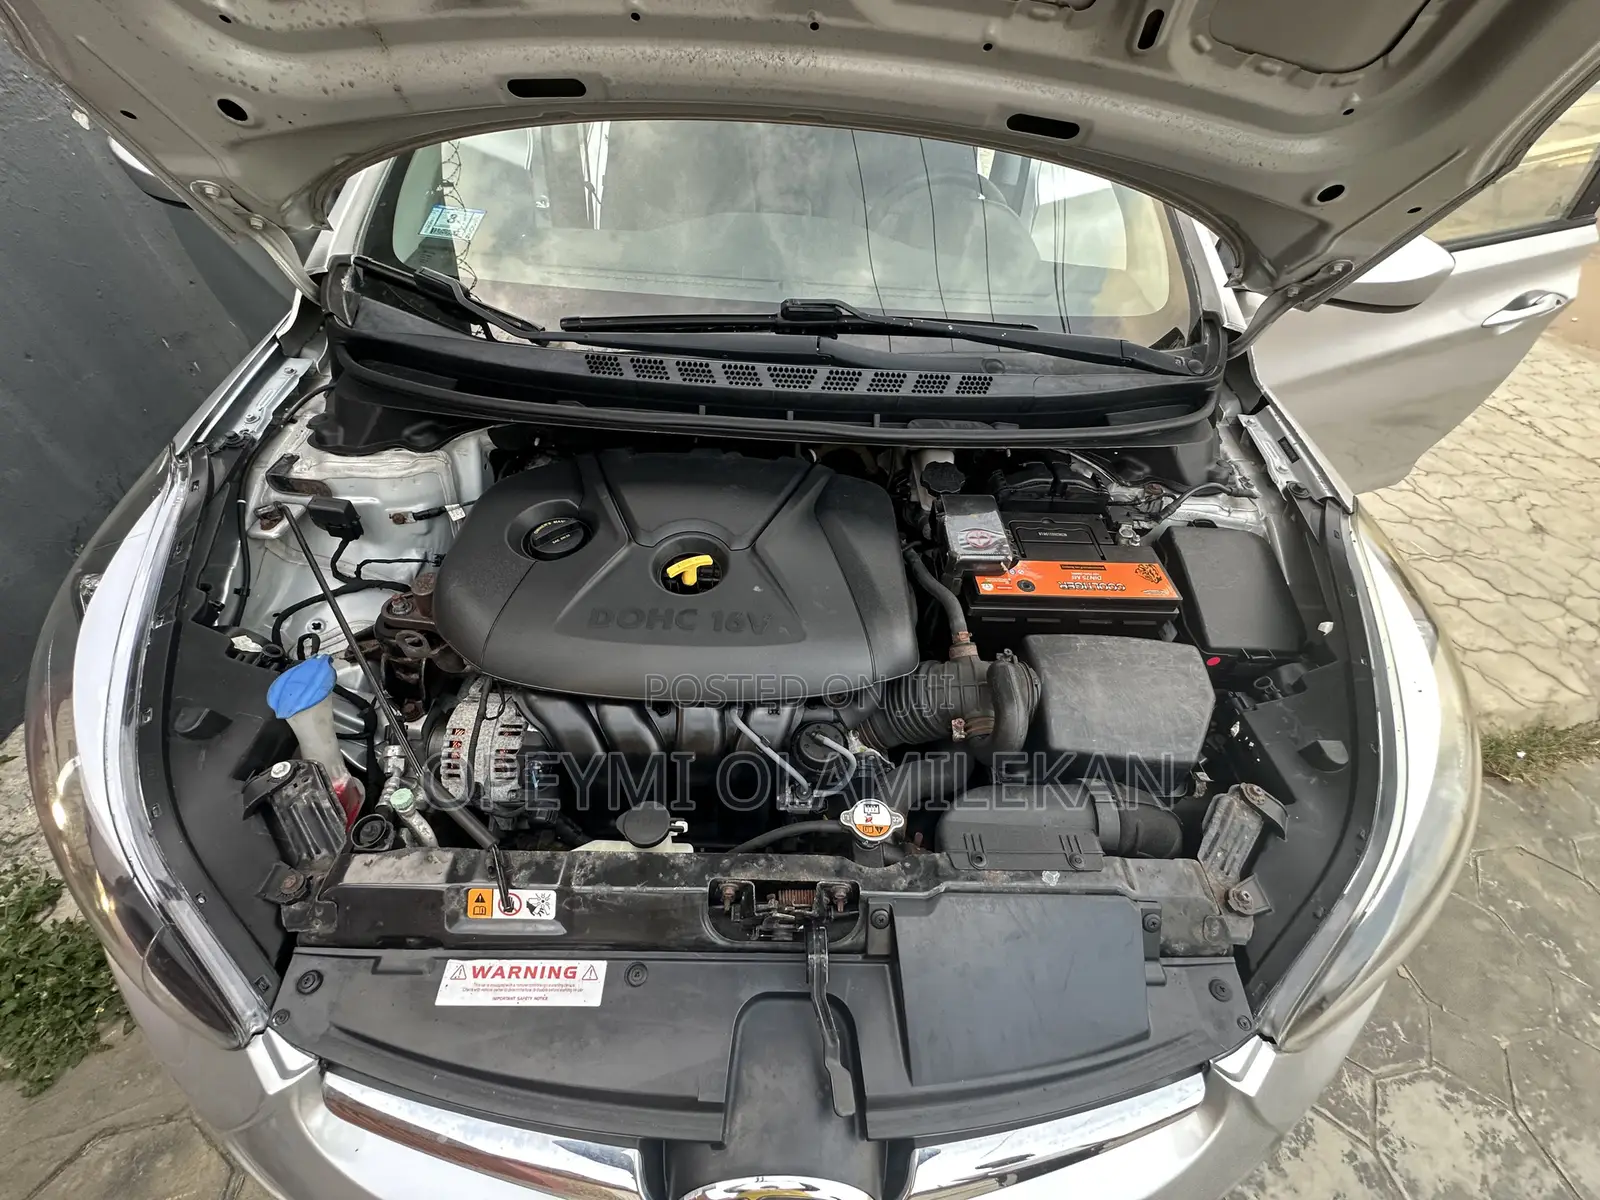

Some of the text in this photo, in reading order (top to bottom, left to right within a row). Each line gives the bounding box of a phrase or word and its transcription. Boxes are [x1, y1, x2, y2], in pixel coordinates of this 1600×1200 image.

[587, 607, 774, 636] DOHC 16V
[471, 965, 578, 979] WARNING
